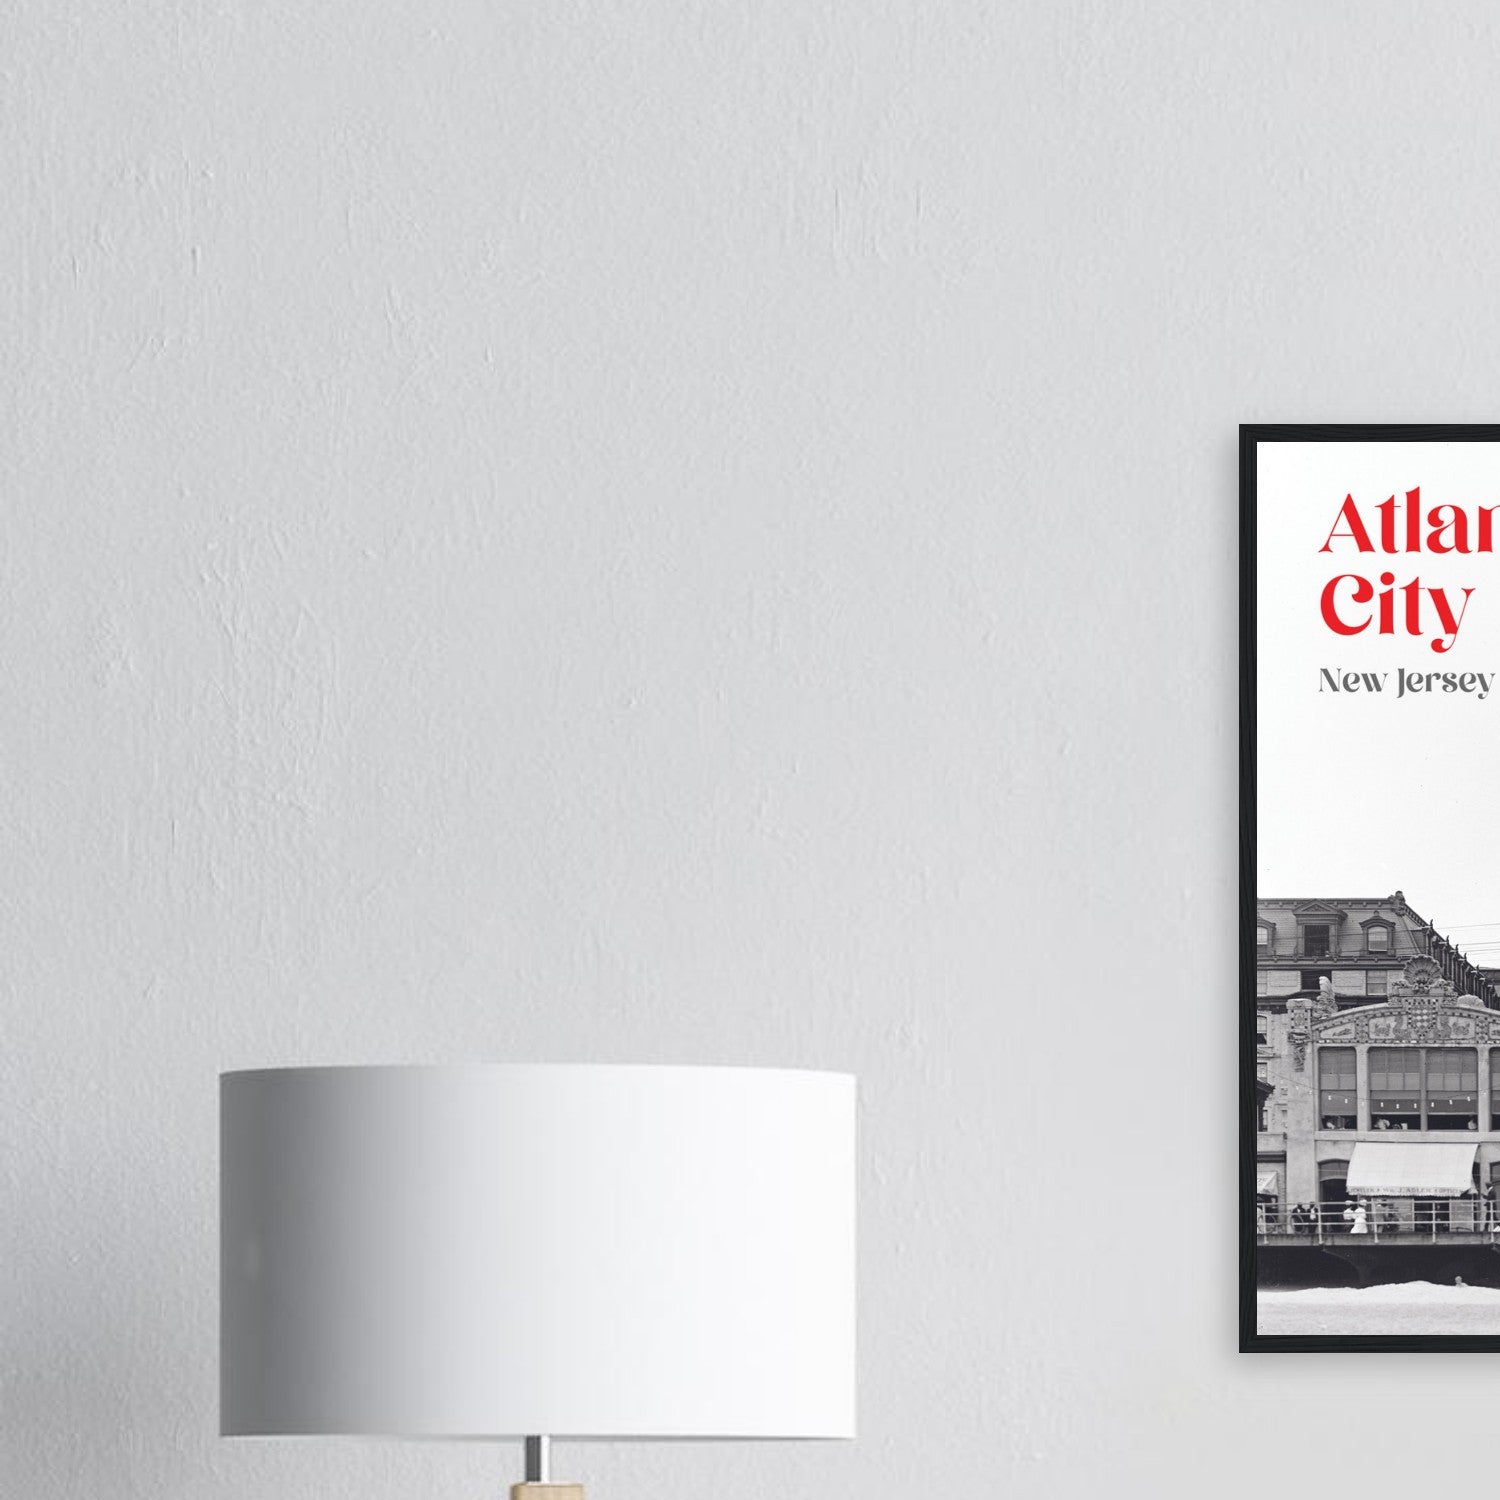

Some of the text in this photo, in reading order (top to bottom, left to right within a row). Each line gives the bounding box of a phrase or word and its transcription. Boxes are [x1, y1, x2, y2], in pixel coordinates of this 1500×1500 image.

[1320, 571, 1476, 653] City
[1318, 668, 1496, 700] New Jersey
